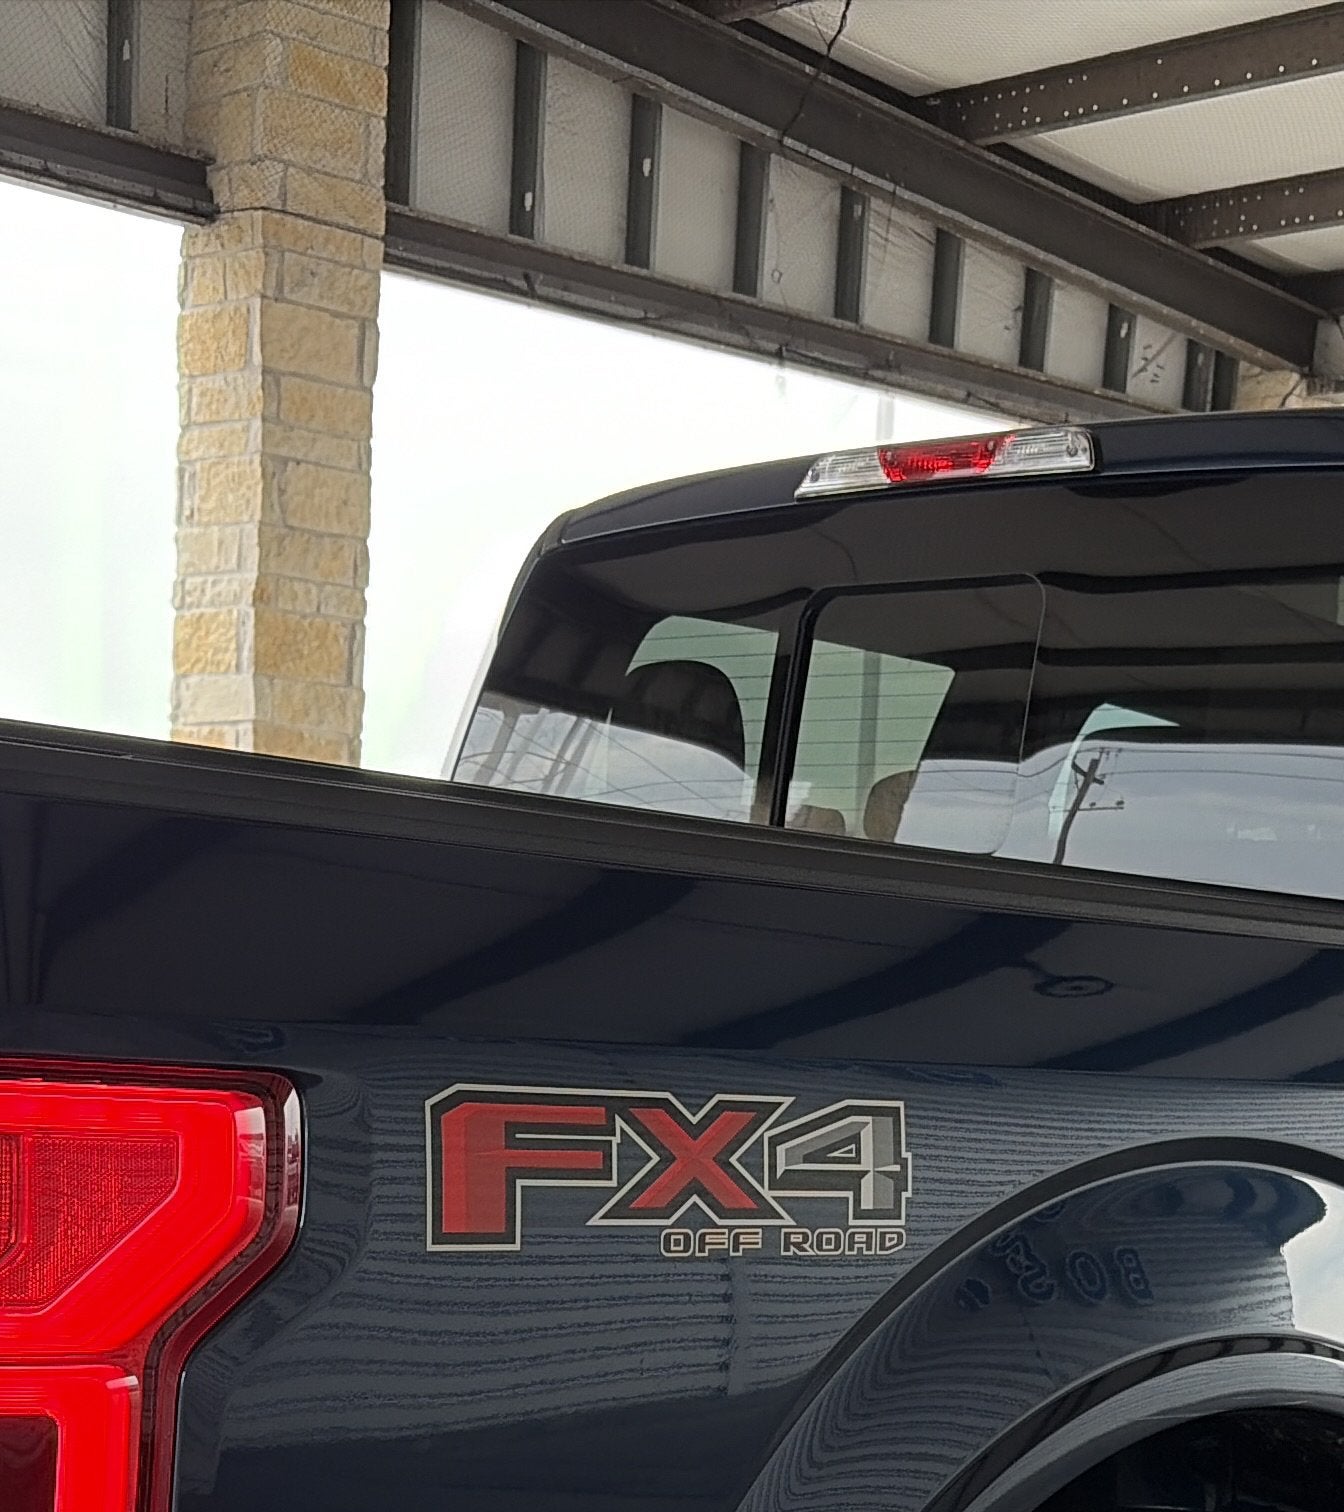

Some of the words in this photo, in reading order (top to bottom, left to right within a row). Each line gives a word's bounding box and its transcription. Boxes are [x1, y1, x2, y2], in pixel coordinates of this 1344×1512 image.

[424, 1083, 913, 1252] FX4
[659, 1228, 763, 1257] OFF
[780, 1228, 907, 1257] ROAD
